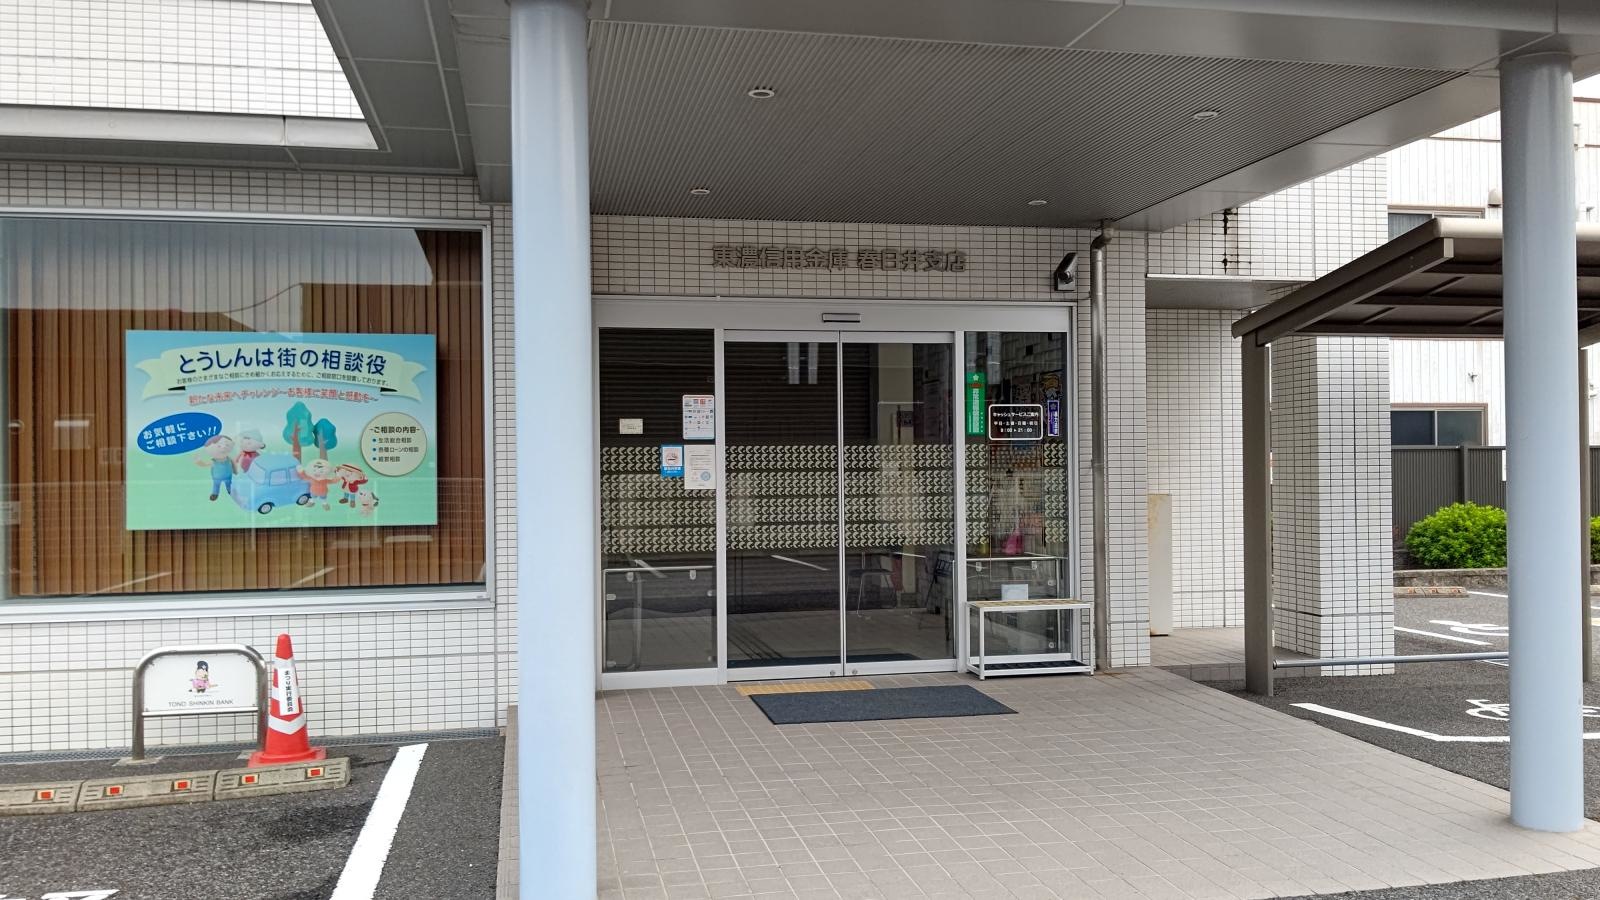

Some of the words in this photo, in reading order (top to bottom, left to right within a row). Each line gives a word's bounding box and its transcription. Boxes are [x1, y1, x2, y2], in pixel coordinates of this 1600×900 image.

[712, 245, 849, 272] 東濃信用金庫
[856, 248, 967, 273] 春日井支店
[179, 347, 387, 376] とうしんは街の相談役
[142, 422, 187, 440] お気軽に
